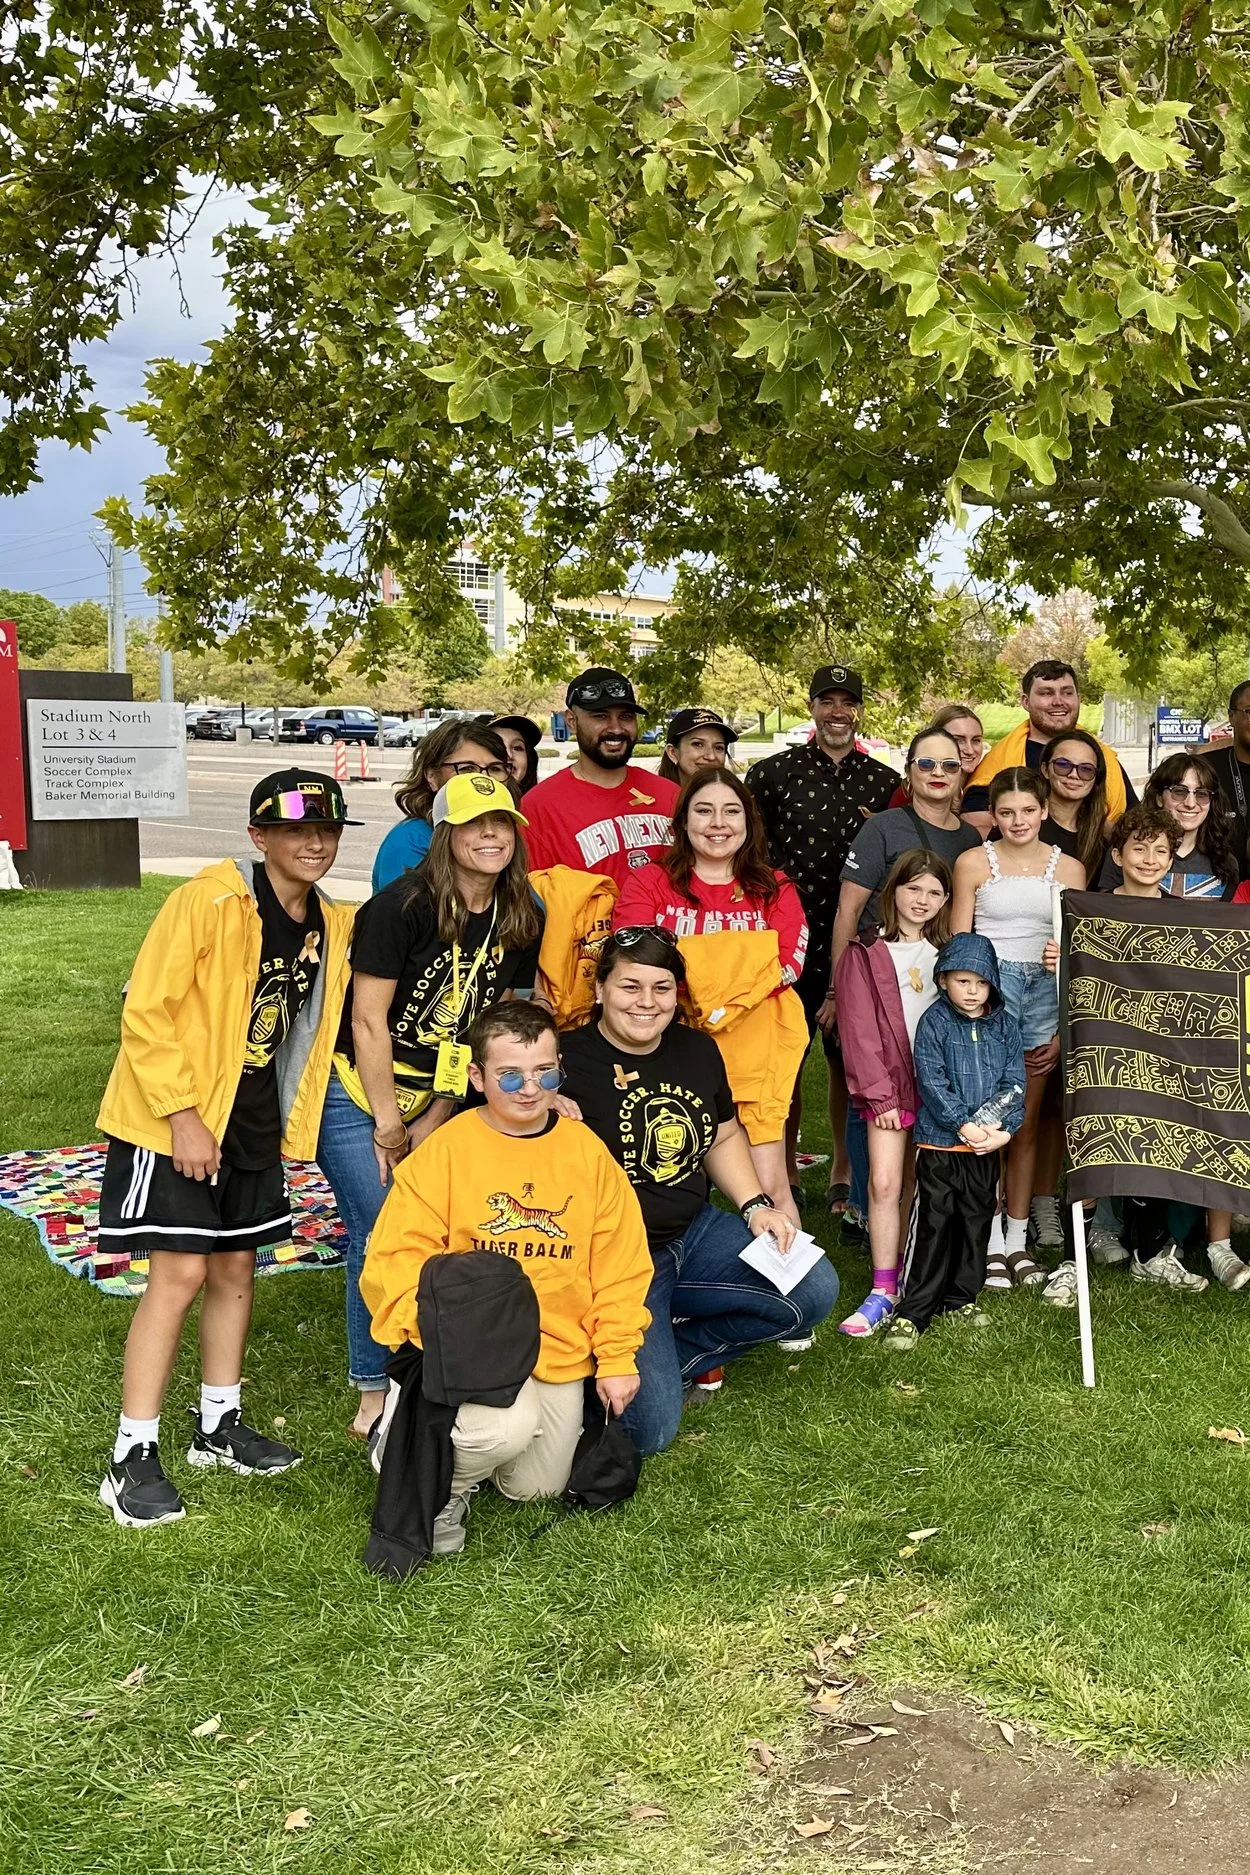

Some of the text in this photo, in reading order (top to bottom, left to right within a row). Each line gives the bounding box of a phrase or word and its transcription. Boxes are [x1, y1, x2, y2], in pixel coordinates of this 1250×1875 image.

[41, 709, 151, 724] Stadium North
[42, 728, 116, 741] Lot 3 & 4
[1159, 725, 1202, 734] BMX LOT
[43, 755, 136, 765] University Stadium
[44, 767, 132, 778] Soccer Complex
[45, 779, 124, 789] Track Complex
[46, 790, 175, 800] Baker Memorial Building
[574, 813, 676, 868] NEW MEXIC
[666, 905, 698, 918] NEW
[624, 1150, 637, 1177] OVE
[660, 1083, 703, 1108] HATE
[524, 1242, 573, 1260] BALM
